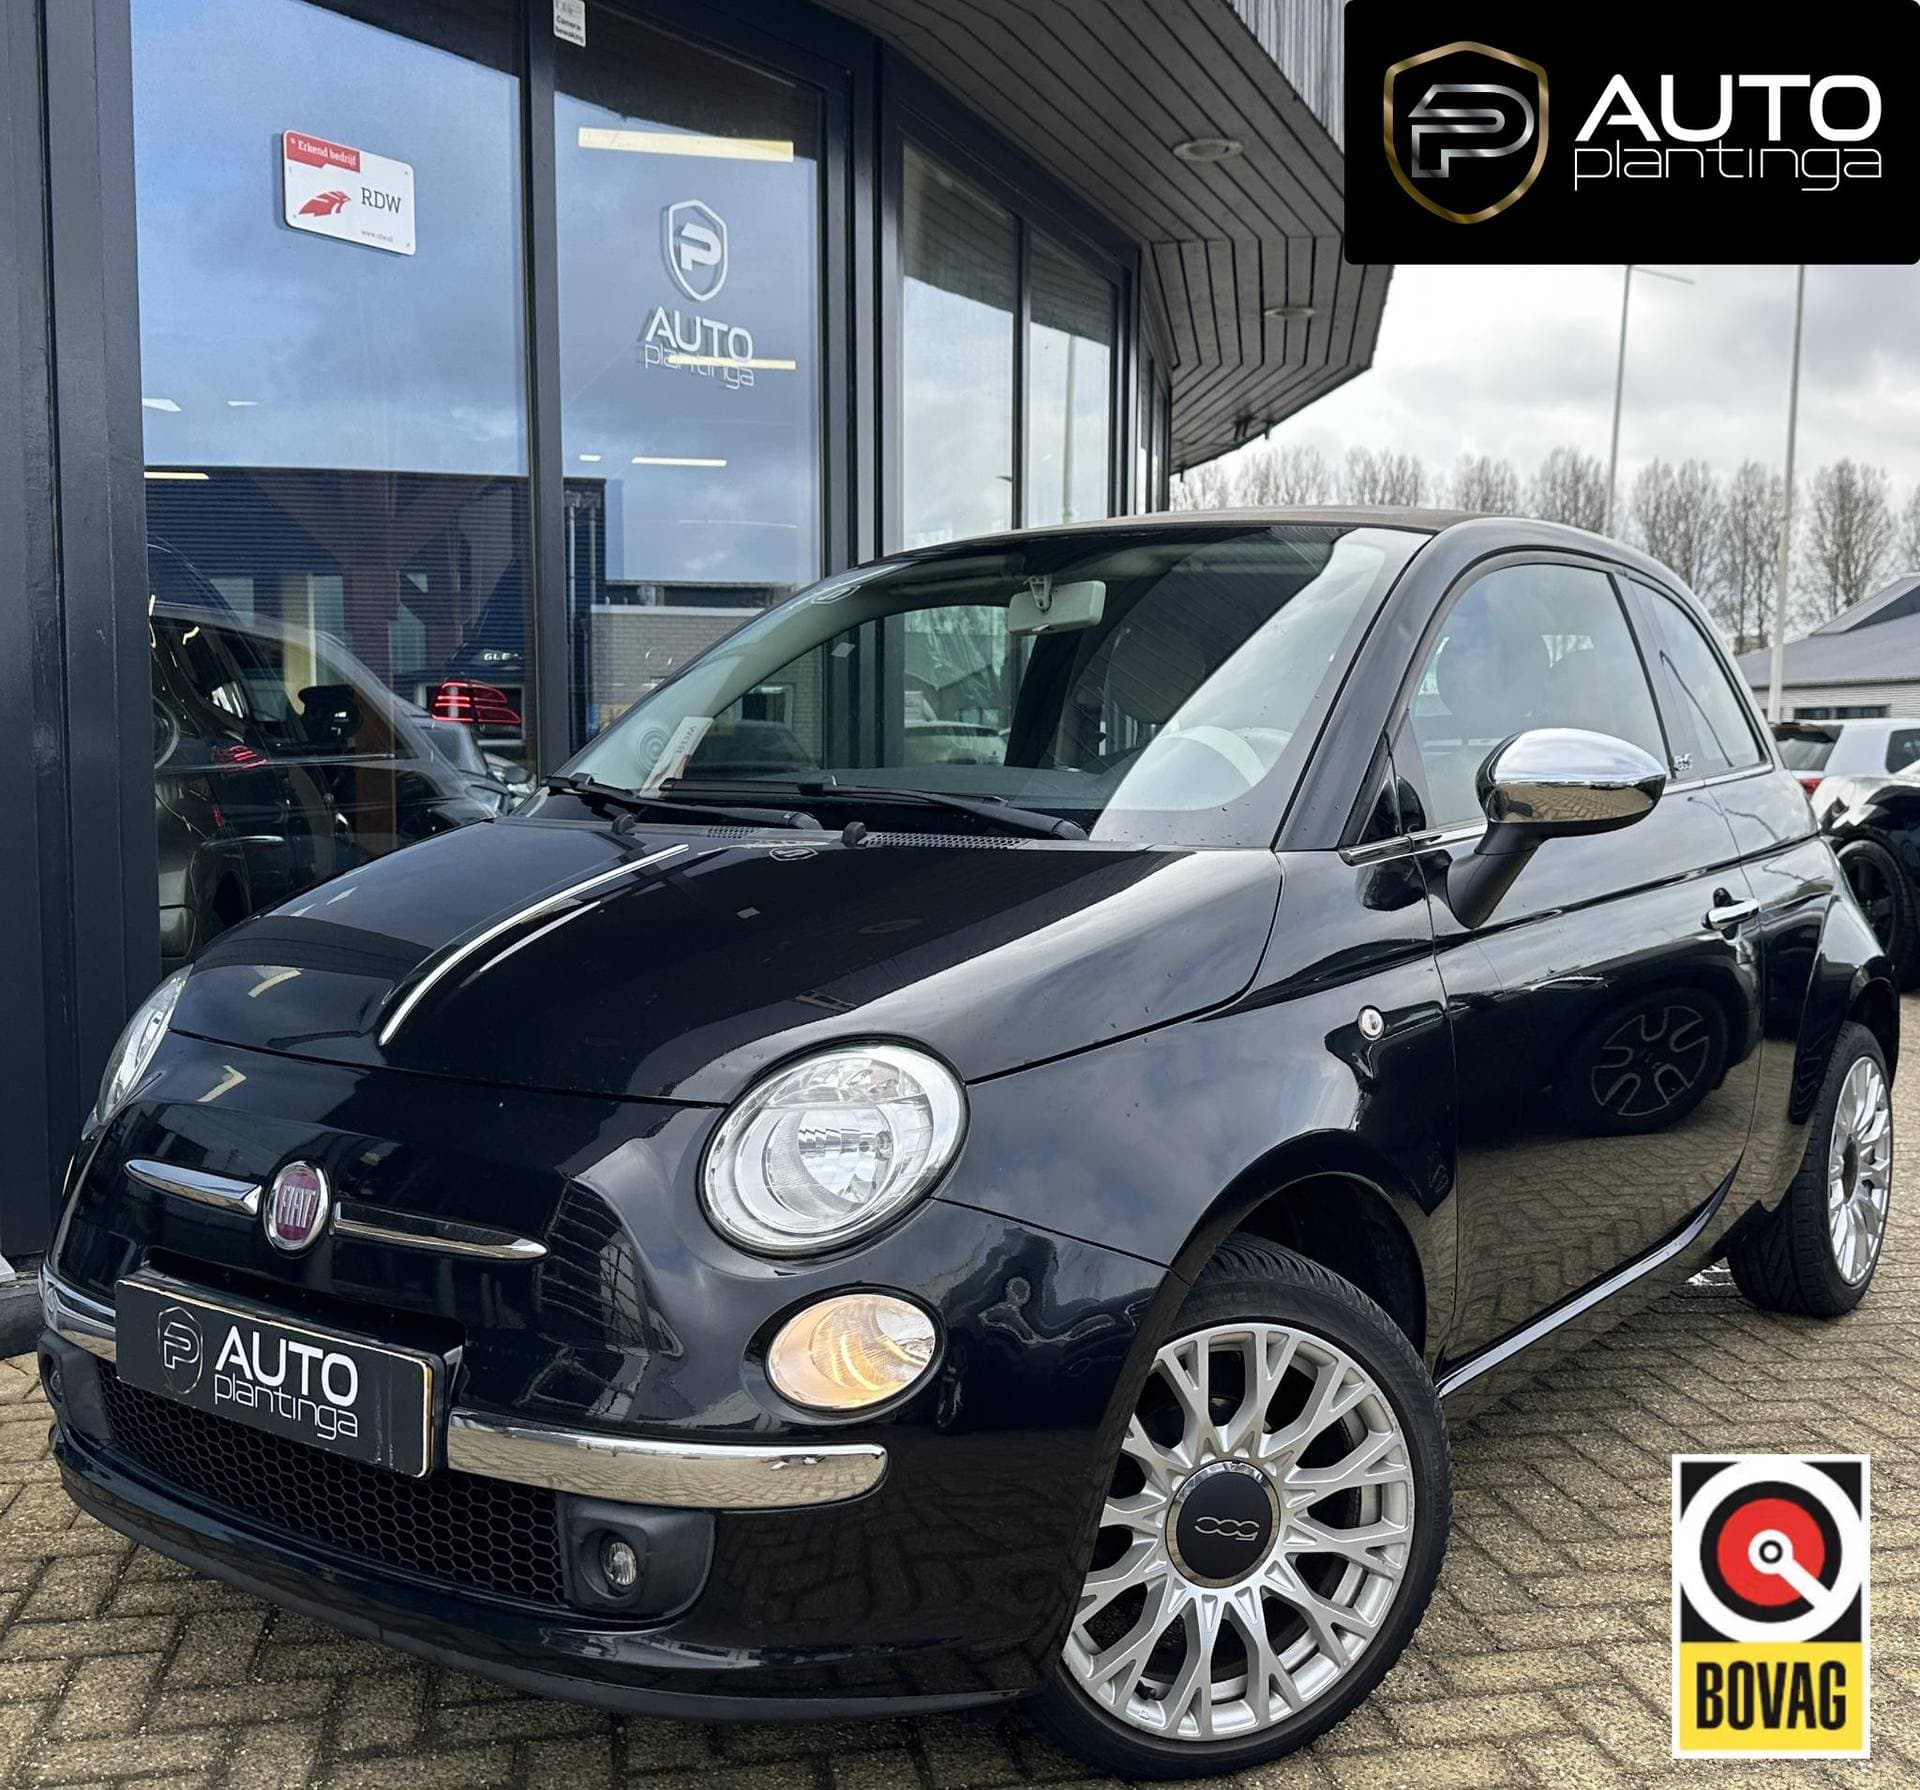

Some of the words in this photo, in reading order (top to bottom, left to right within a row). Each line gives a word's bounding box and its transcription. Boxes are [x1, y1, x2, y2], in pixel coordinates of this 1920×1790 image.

[298, 140, 329, 158] Erkend
[329, 148, 357, 167] bedrijf
[361, 187, 401, 214] RDW
[645, 305, 754, 362] AUTO
[278, 1185, 316, 1228] FIAT
[214, 1325, 359, 1407] AUTO
[214, 1373, 358, 1440] plantinga
